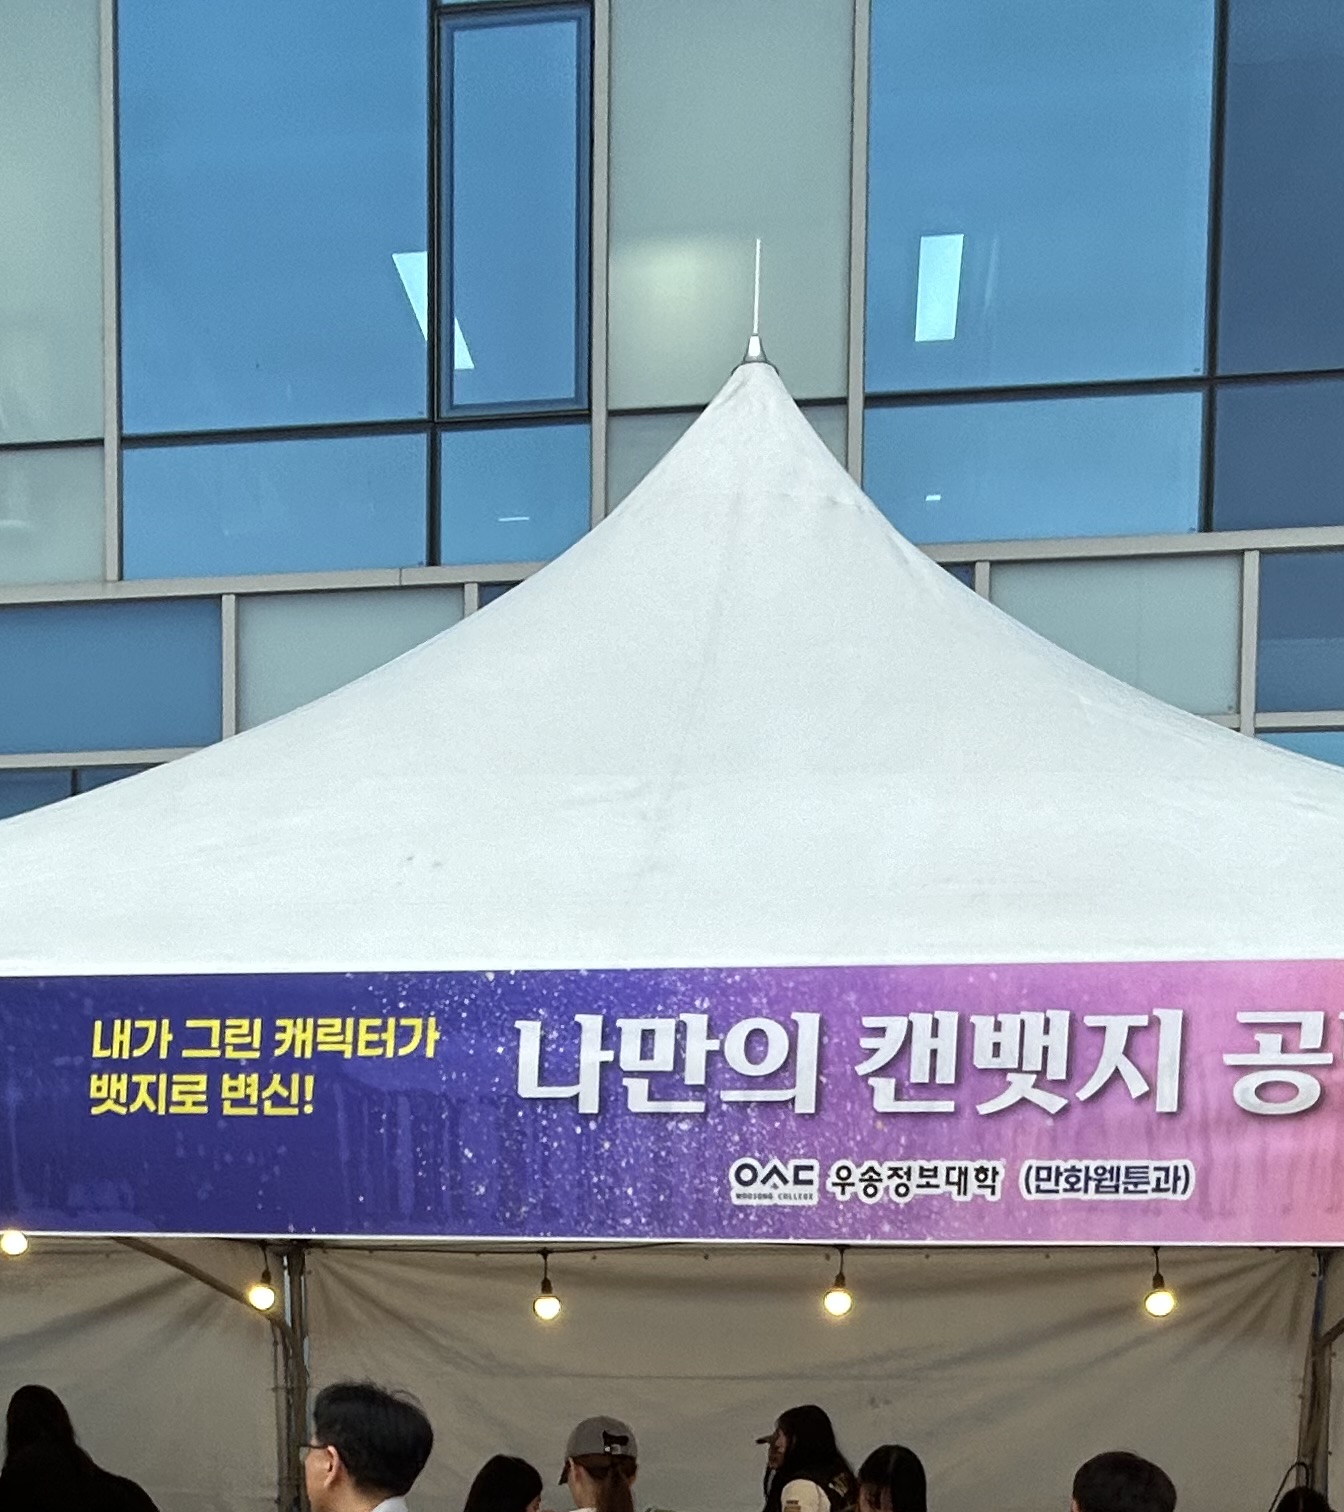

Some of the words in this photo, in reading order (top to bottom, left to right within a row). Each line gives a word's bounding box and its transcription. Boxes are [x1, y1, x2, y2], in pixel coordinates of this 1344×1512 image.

[90, 1018, 174, 1060] 내가
[181, 1016, 262, 1060] 그린
[274, 1015, 441, 1060] 캐릭터가
[512, 1012, 820, 1116] 나만의
[855, 1005, 1186, 1117] 캔뱃지
[89, 1072, 209, 1116] 뱃지로
[219, 1072, 315, 1117] 변신!
[831, 1164, 1000, 1199] 우송정보대학
[1023, 1164, 1191, 1196] (만화웹툰과)
